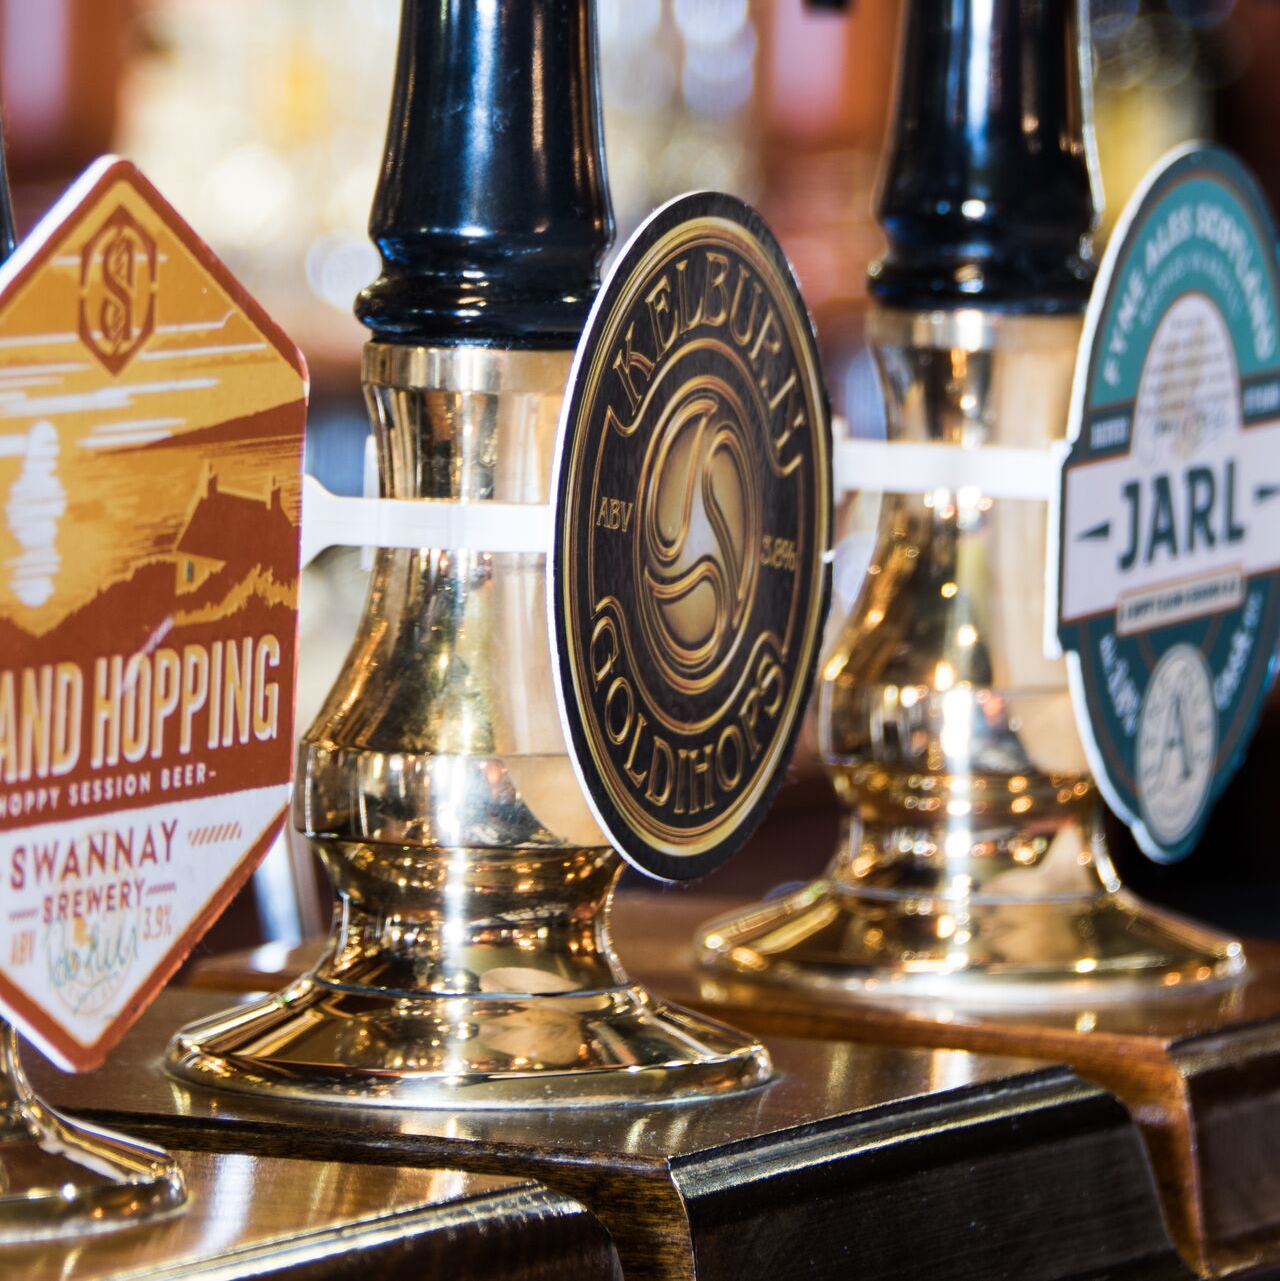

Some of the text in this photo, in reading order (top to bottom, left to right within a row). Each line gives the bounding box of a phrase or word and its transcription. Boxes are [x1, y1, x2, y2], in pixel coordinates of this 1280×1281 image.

[613, 252, 804, 449] KELBURN
[596, 496, 634, 533] ABV
[1118, 456, 1246, 573] JARL
[91, 634, 281, 769] HOPPING
[590, 615, 786, 815] GOLDIHOPS
[68, 772, 151, 807] SESSION
[10, 818, 179, 890] SWANNAY
[43, 878, 146, 925] BREWERY
